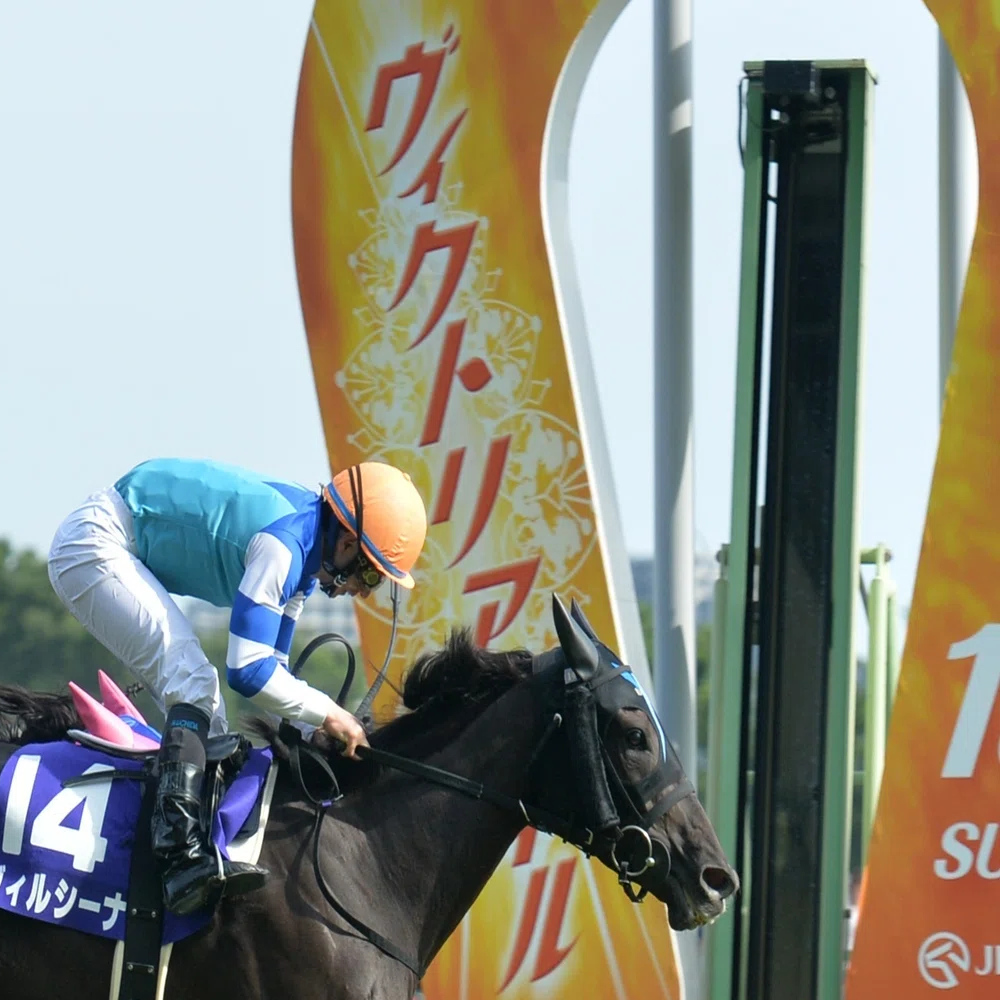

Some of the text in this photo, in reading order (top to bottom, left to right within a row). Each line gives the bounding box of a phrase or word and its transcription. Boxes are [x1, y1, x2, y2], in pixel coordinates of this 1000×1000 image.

[941, 622, 1000, 779] 1
[2, 754, 116, 873] 14
[974, 944, 1000, 976] J
